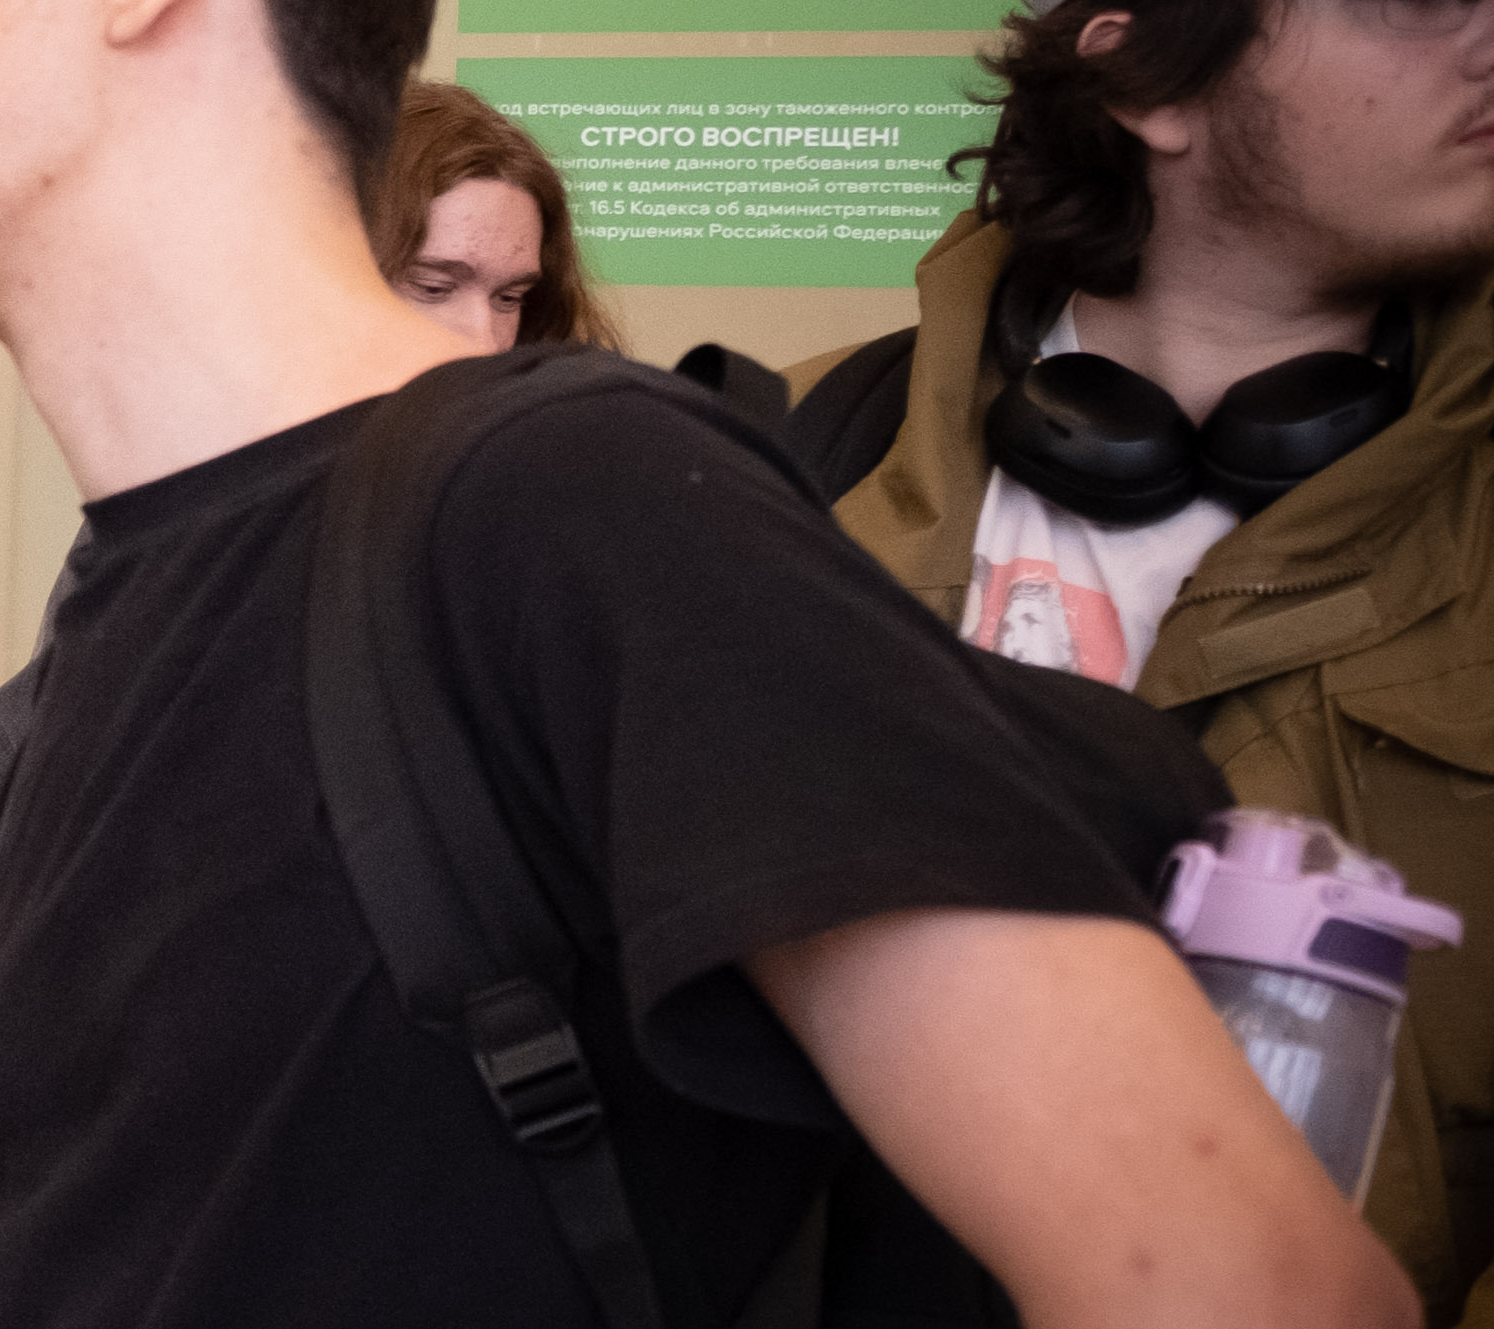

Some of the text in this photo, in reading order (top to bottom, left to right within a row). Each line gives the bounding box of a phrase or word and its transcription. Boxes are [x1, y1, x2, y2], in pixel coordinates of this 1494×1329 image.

[527, 103, 662, 118] встречающих
[666, 103, 704, 117] лиц
[708, 103, 721, 116] в
[725, 103, 772, 118] зону
[776, 103, 910, 116] таможенного
[580, 126, 901, 151] СТРОГО ВОСПРЕЩЕН!
[674, 158, 758, 172] данного
[763, 155, 879, 172] требования
[884, 158, 945, 171] влече
[627, 178, 820, 195] административной
[823, 182, 980, 194] ответственнос
[589, 200, 626, 216] 16.5
[630, 200, 711, 217] Кодекса
[715, 200, 740, 217] об
[743, 204, 941, 220] административных
[708, 222, 829, 240] Российской
